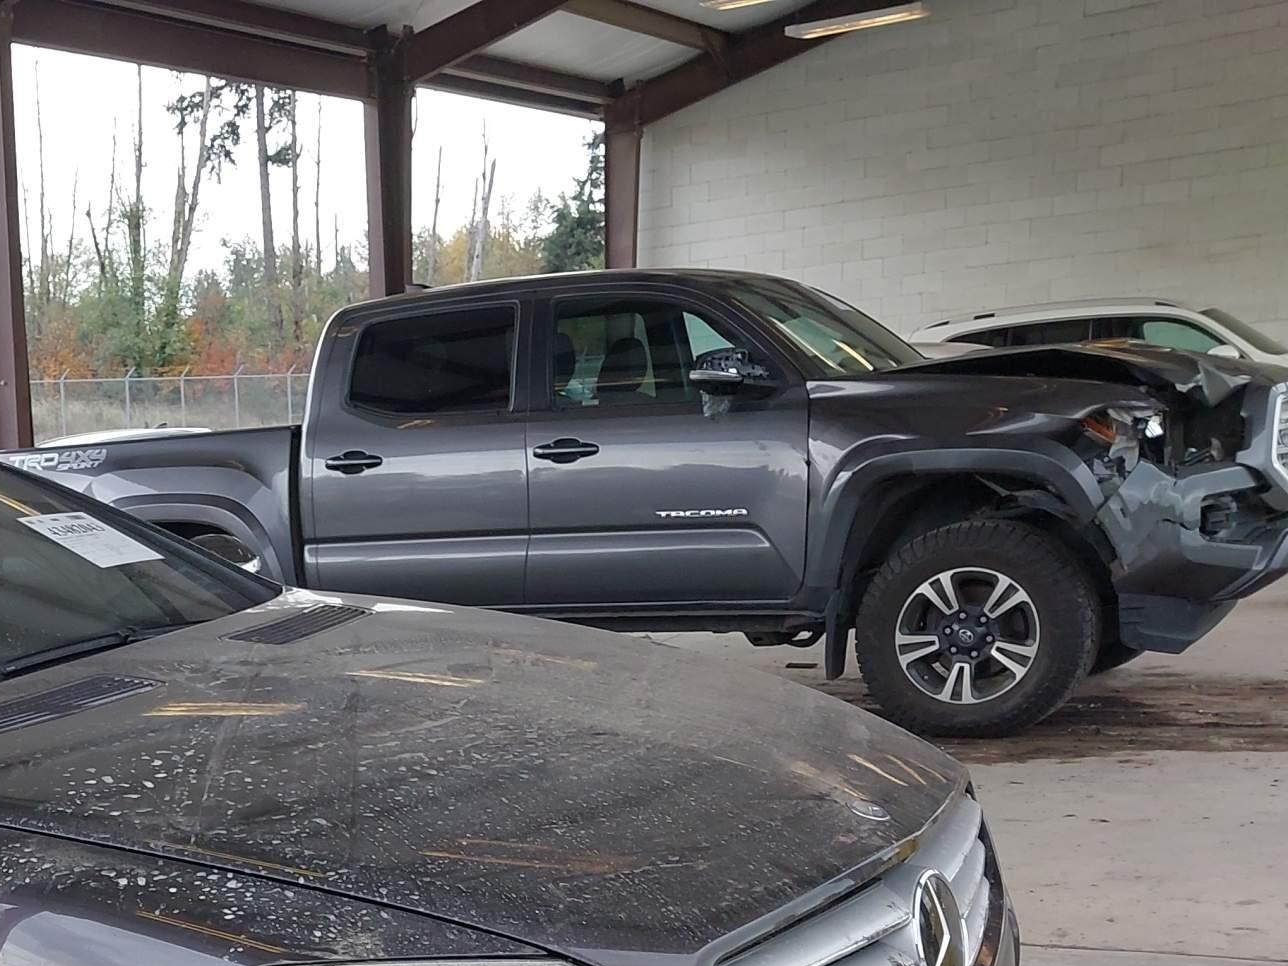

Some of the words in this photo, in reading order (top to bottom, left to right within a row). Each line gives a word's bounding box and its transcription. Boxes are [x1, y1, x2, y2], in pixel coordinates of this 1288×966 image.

[9, 453, 59, 471] TRD
[56, 461, 103, 471] SPORT
[655, 508, 749, 518] TACOMA
